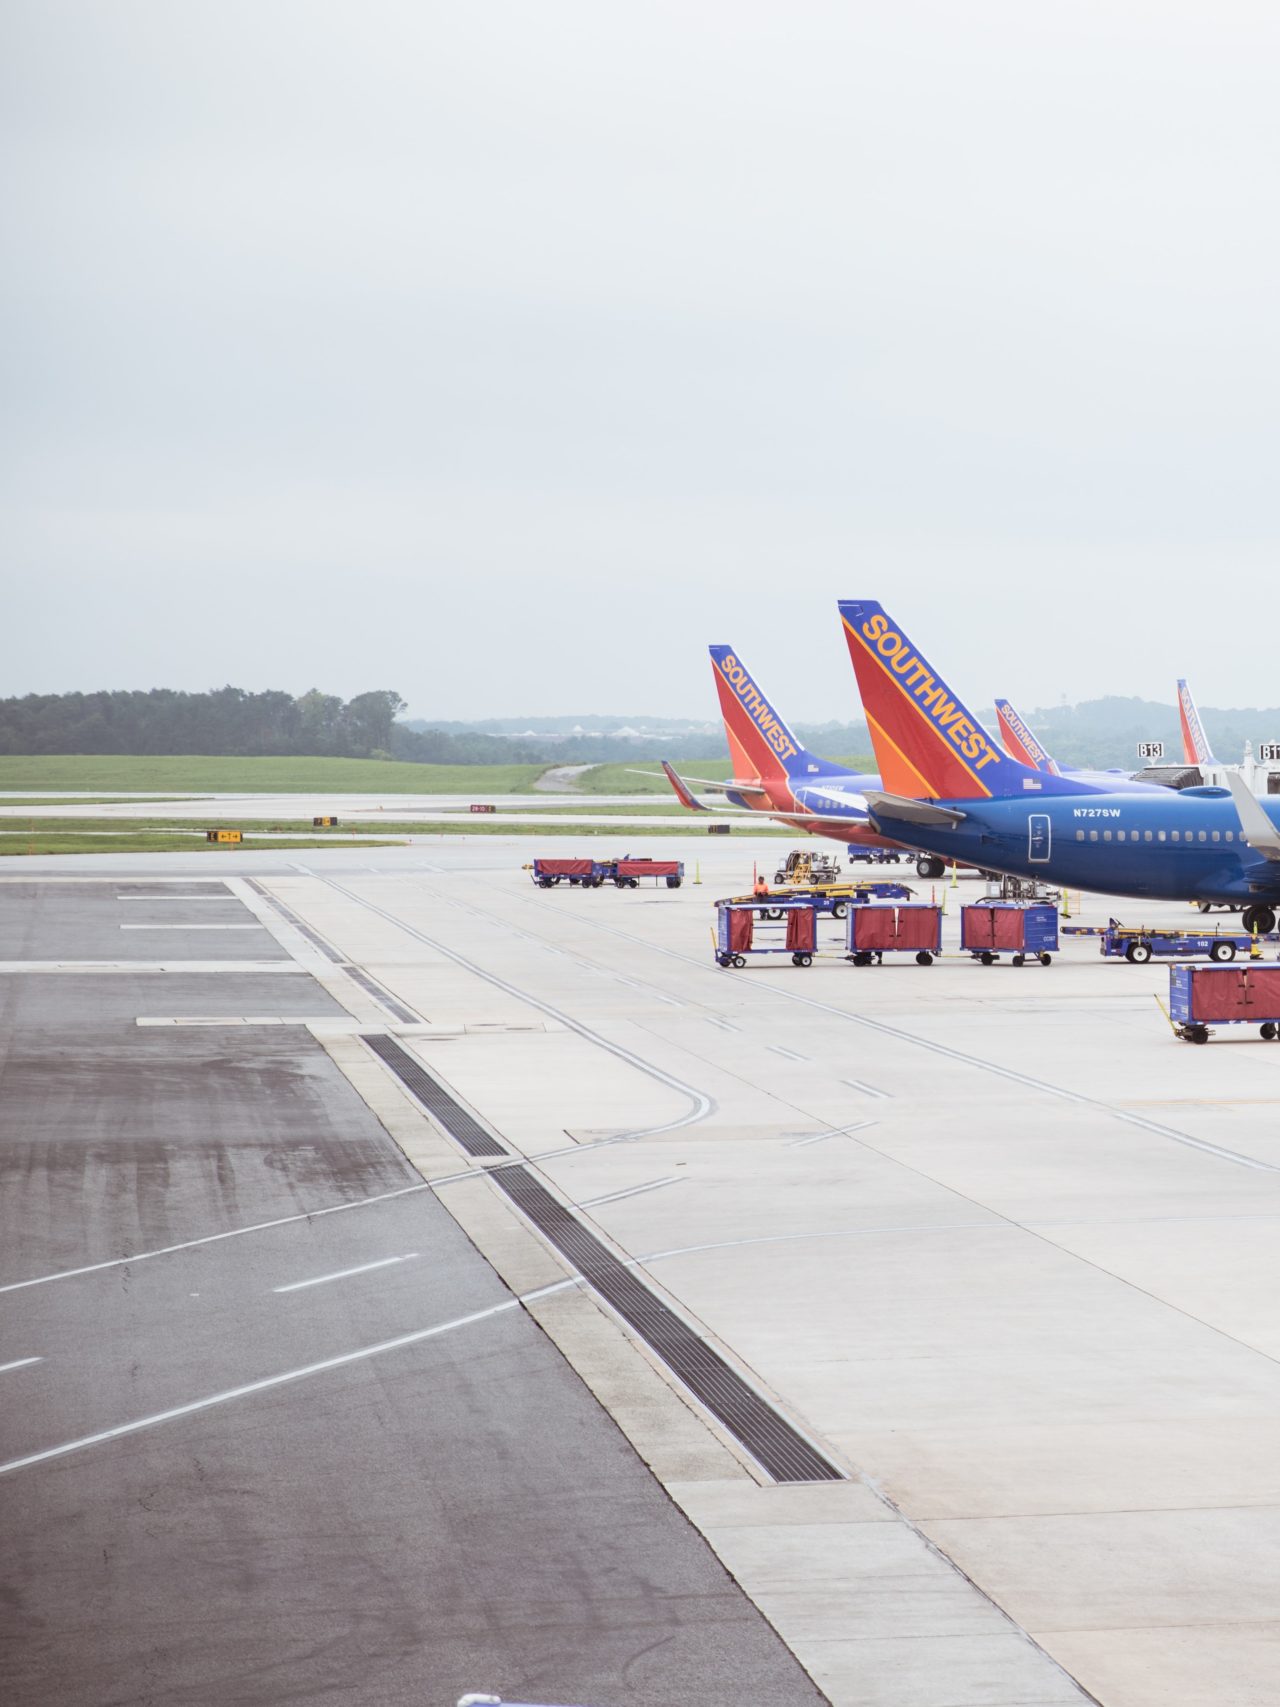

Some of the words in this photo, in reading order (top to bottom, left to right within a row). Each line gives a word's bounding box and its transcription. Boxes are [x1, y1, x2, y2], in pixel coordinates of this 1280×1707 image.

[721, 655, 797, 760] SOUTHWEST
[862, 614, 1001, 770] SOUTHWEST
[1181, 687, 1209, 765] SOUTHWEST
[1001, 704, 1045, 763] SOUTHWEST
[1140, 744, 1161, 757] B13
[1073, 808, 1121, 818] N727SW
